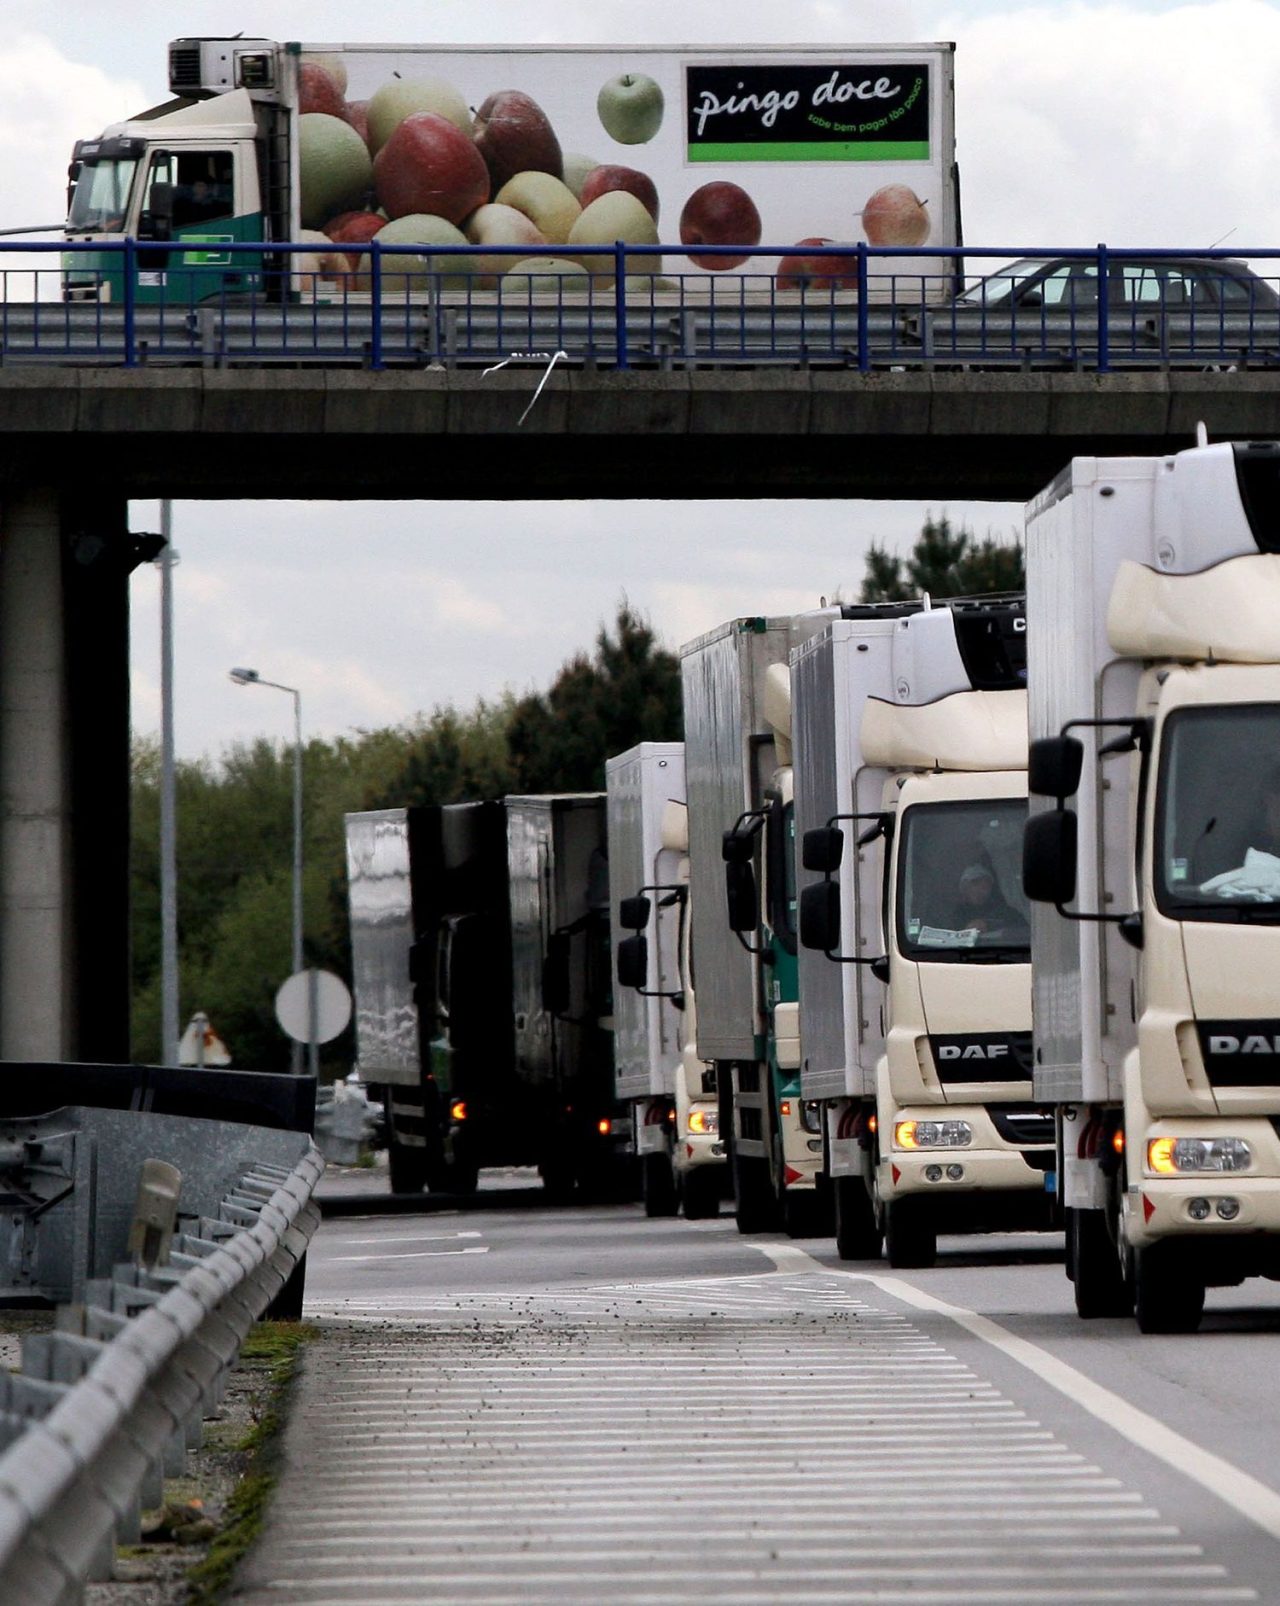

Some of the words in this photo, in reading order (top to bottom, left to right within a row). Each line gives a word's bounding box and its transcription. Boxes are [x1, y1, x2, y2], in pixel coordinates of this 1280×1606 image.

[693, 82, 799, 136] pingo
[812, 71, 901, 106] doce
[808, 114, 831, 129] sabe
[833, 122, 857, 132] bem
[859, 117, 888, 132] pagar
[904, 78, 922, 110] pouco
[939, 1045, 1008, 1060] DAF
